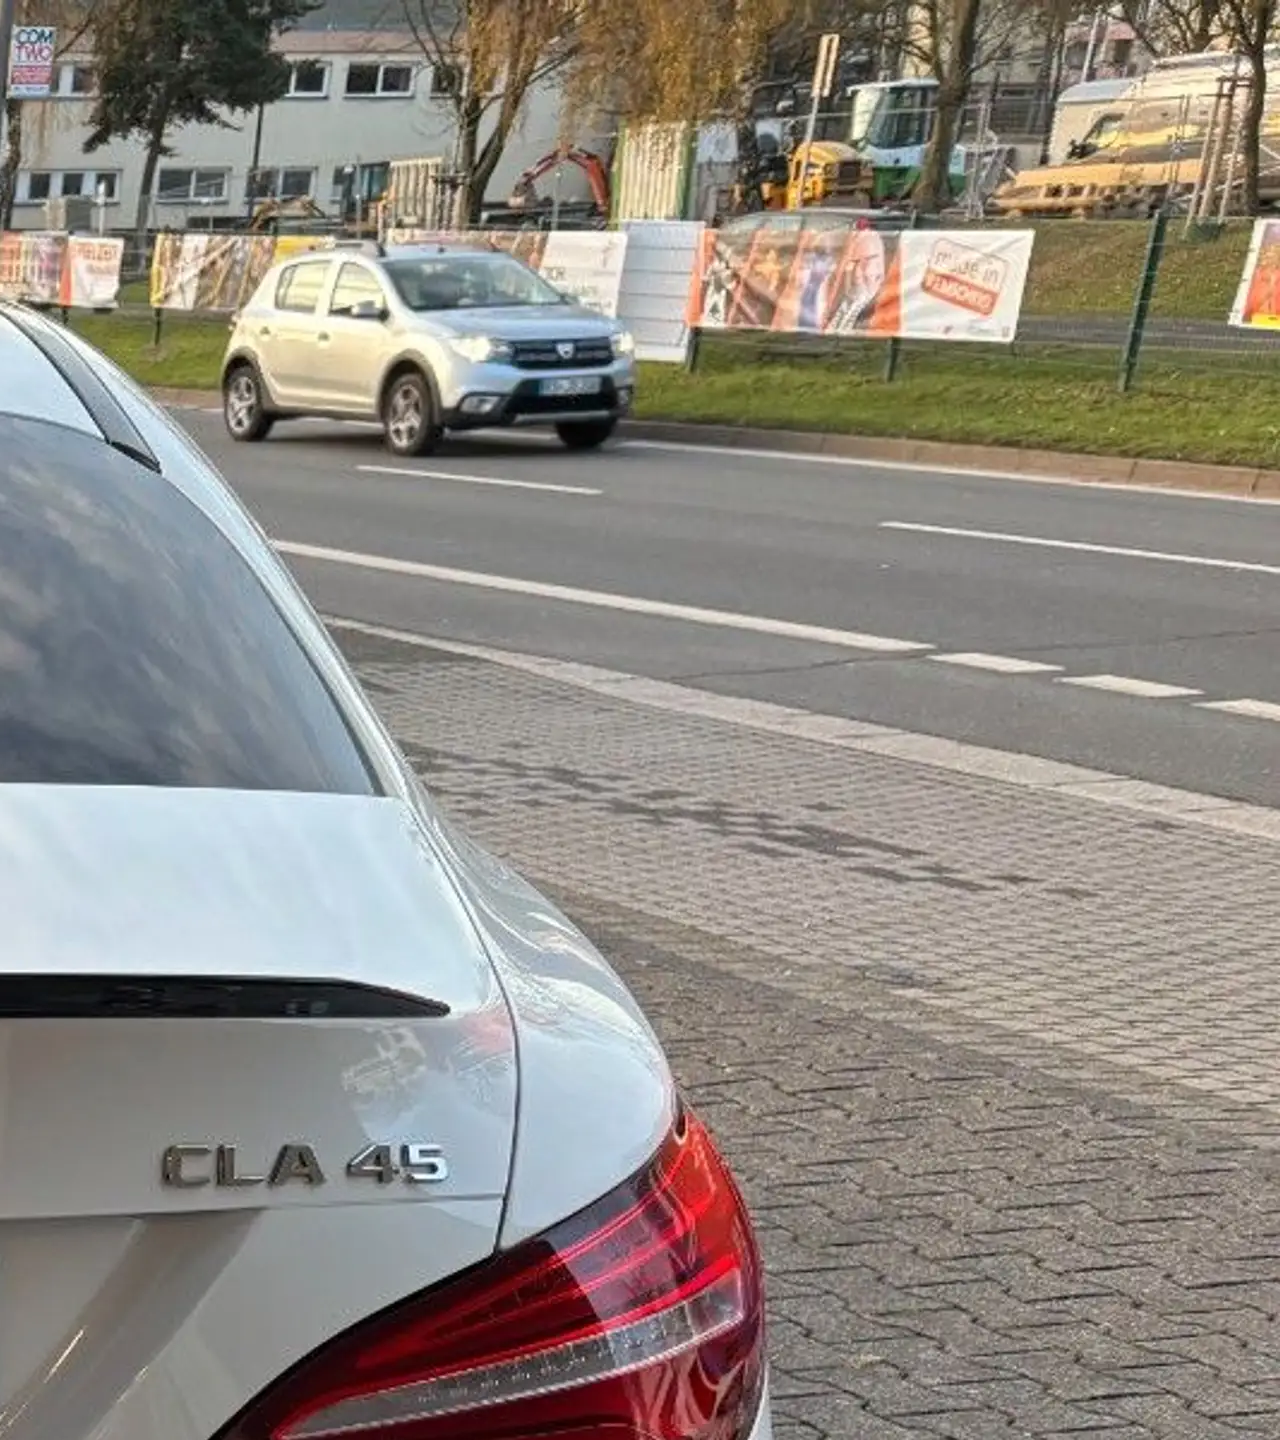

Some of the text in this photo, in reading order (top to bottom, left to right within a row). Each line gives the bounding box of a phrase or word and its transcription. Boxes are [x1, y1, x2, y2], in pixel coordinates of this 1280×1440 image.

[16, 29, 54, 45] COM
[15, 44, 52, 61] TWO
[162, 1143, 449, 1188] CLA 45
